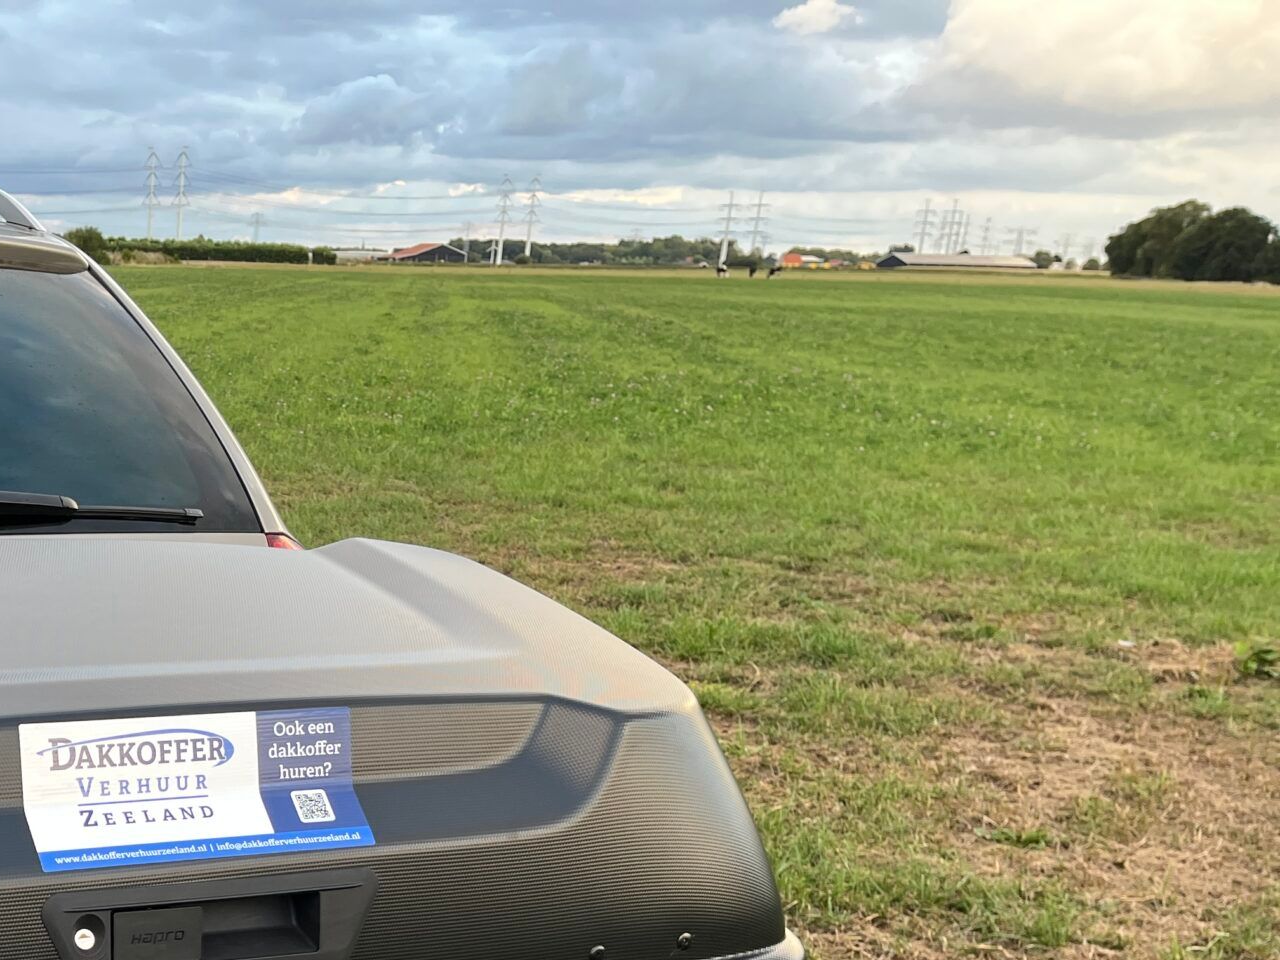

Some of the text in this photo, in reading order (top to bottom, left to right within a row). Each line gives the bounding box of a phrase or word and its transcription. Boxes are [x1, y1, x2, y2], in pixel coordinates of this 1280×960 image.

[273, 721, 335, 737] Ook een
[48, 737, 226, 772] DAKKOFFER
[268, 740, 341, 759] dakkoffer
[279, 761, 332, 780] huren?
[76, 774, 208, 797] VERHUUR
[79, 805, 214, 827] ZEELAND
[55, 844, 207, 866] www.dakkofferverhuurzeeland.nl
[216, 832, 361, 852] info@dakkofferverhuurzeeland.nl
